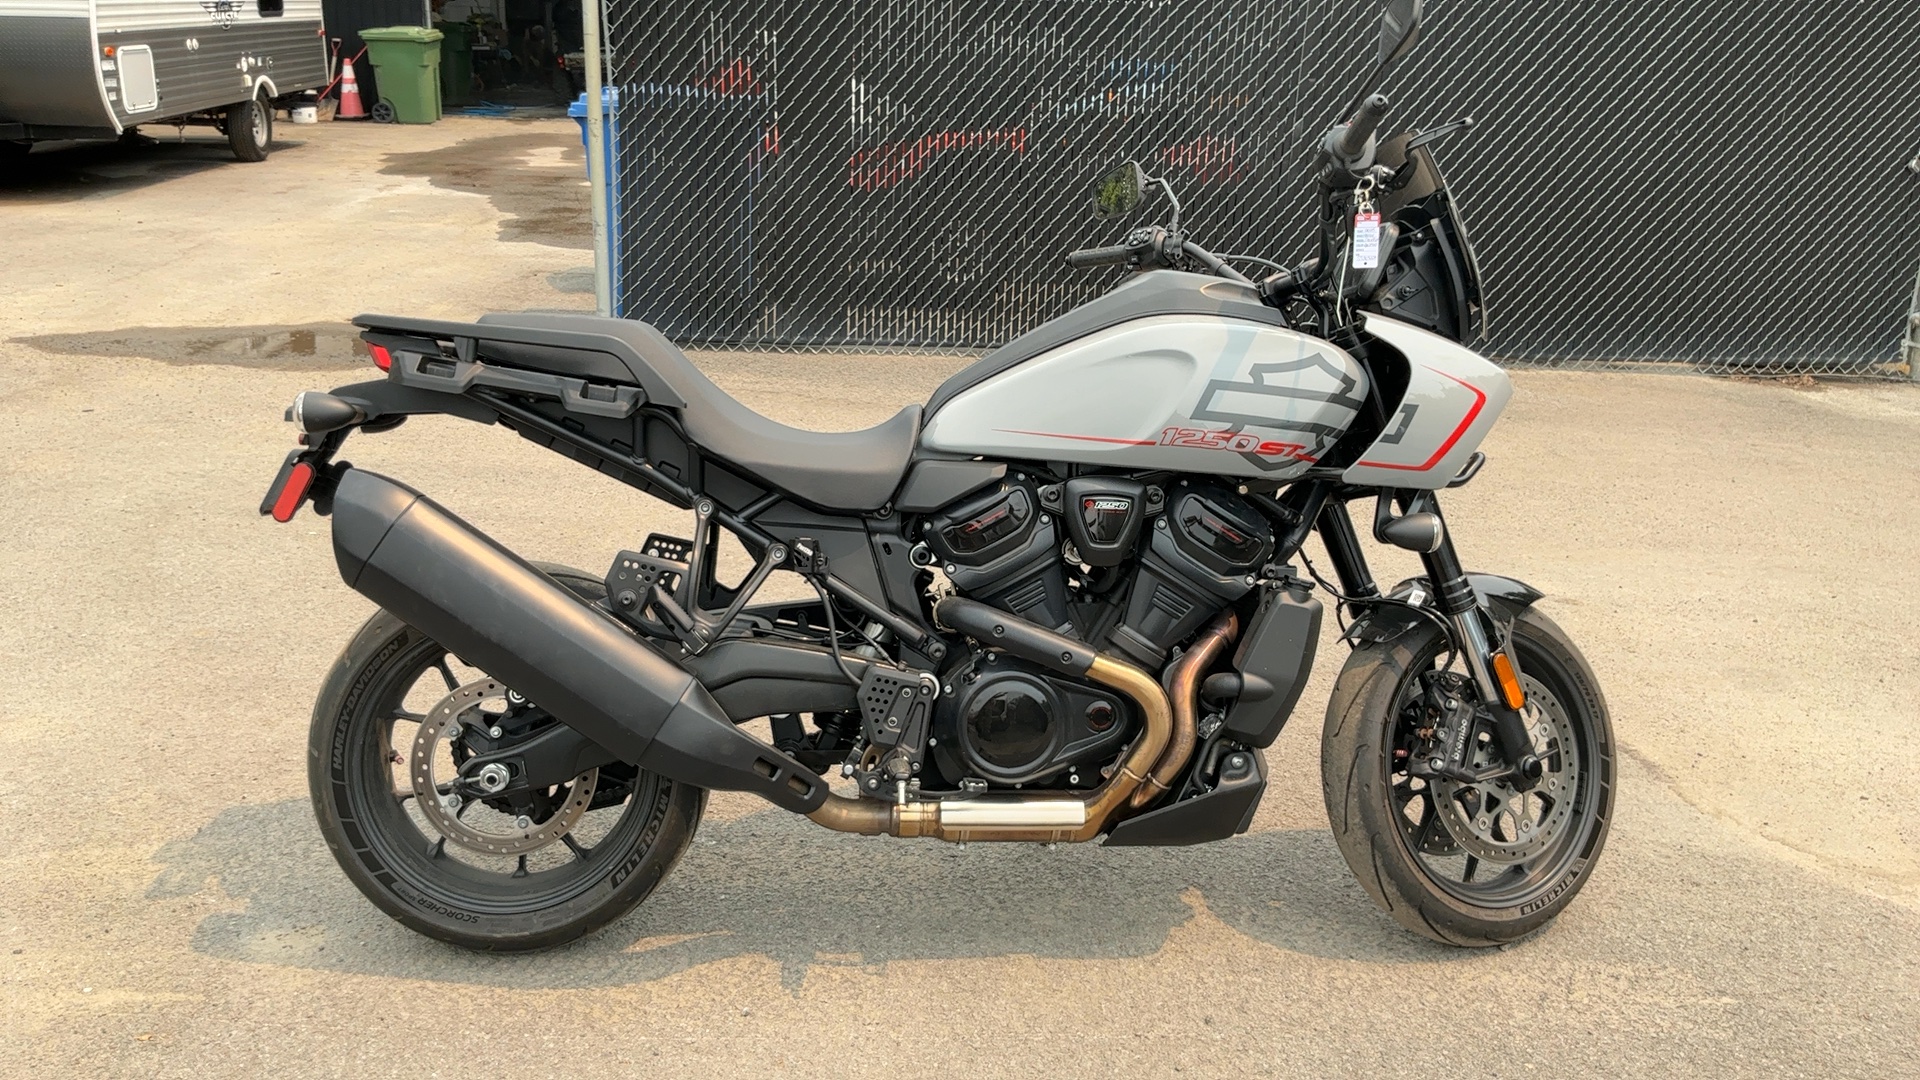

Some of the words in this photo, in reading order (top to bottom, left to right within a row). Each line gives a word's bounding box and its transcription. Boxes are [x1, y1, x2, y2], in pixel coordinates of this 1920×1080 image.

[333, 639, 399, 770] HARLEY-DAVIDSON
[1452, 719, 1468, 761] brembo
[614, 794, 669, 884] MICHELIN
[396, 887, 417, 901] SPORT
[417, 898, 480, 923] SCORCHER
[1523, 873, 1574, 914] MICHELIN
